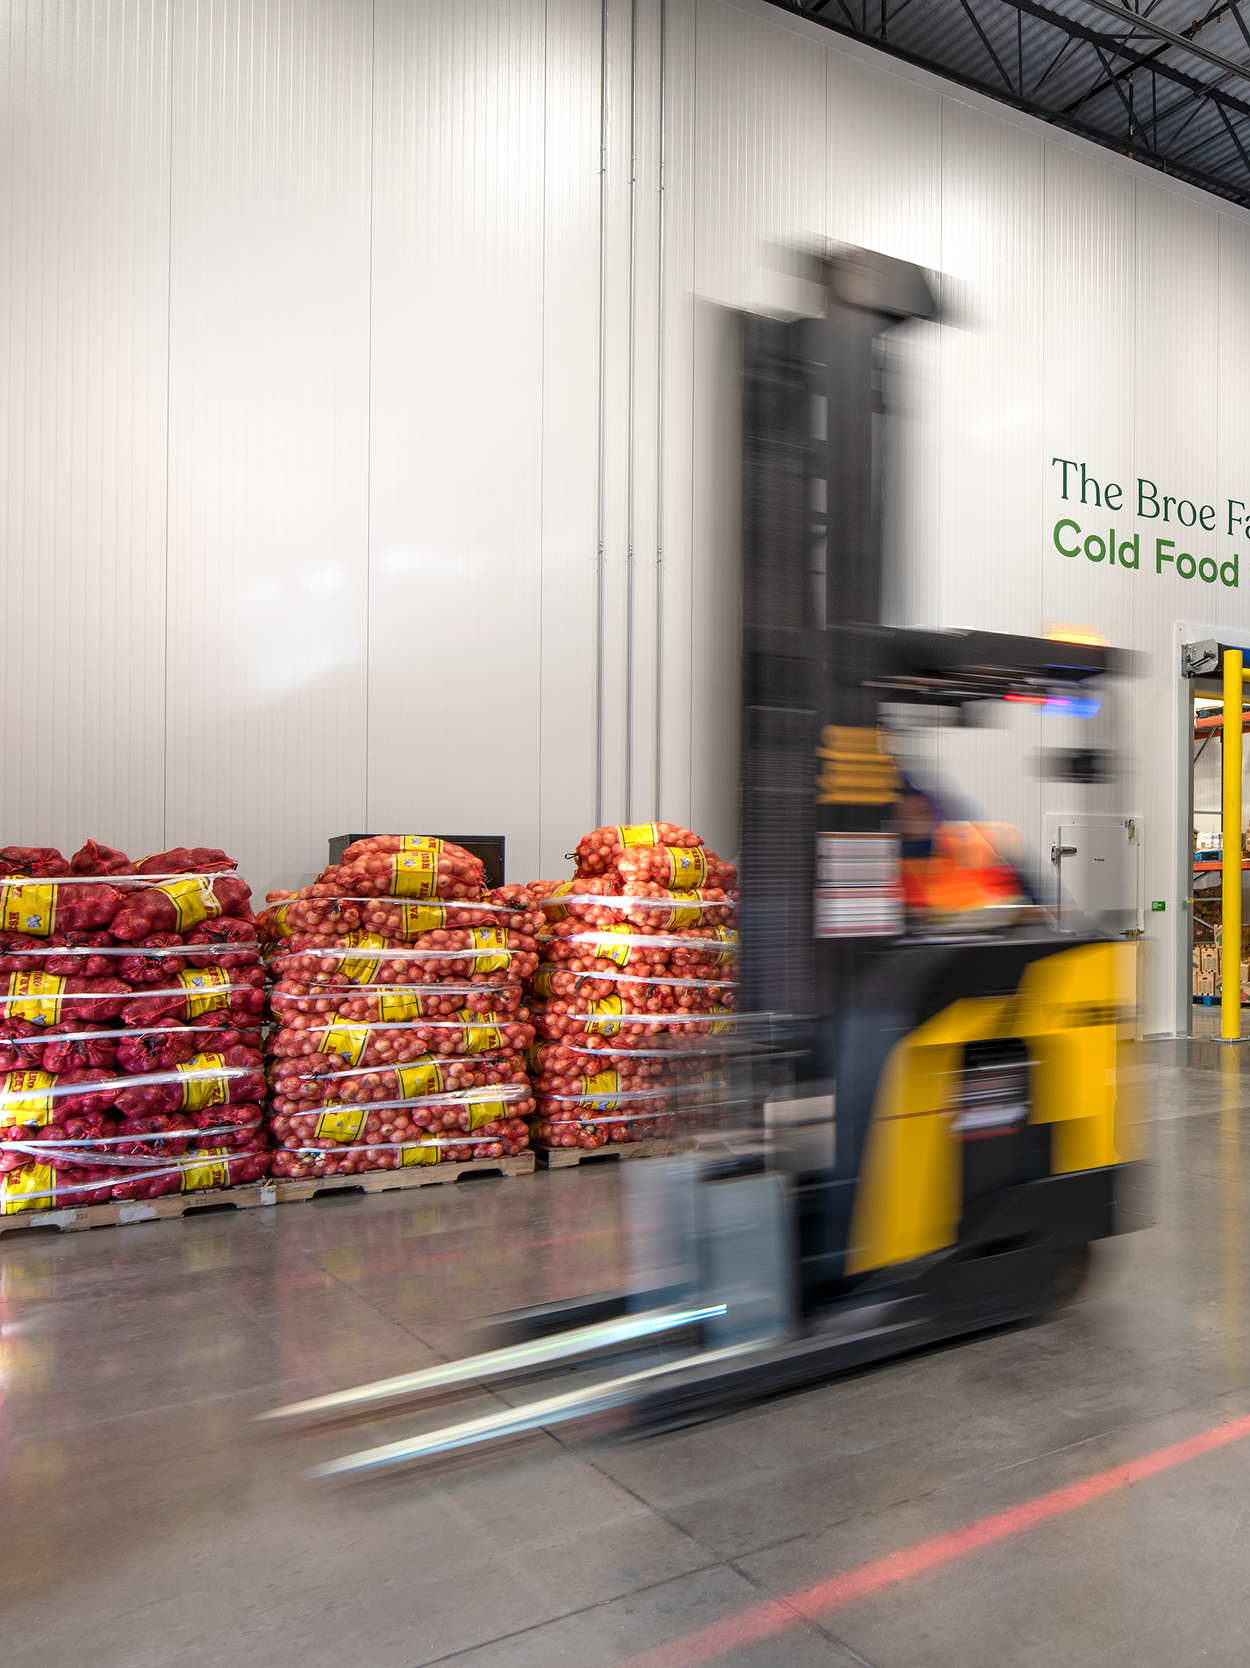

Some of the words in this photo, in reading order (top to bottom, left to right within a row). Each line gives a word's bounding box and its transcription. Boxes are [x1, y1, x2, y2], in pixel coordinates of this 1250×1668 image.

[1052, 457, 1123, 511] The
[1136, 478, 1216, 531] Broe
[1053, 518, 1140, 570] Cold
[1155, 538, 1239, 588] Food
